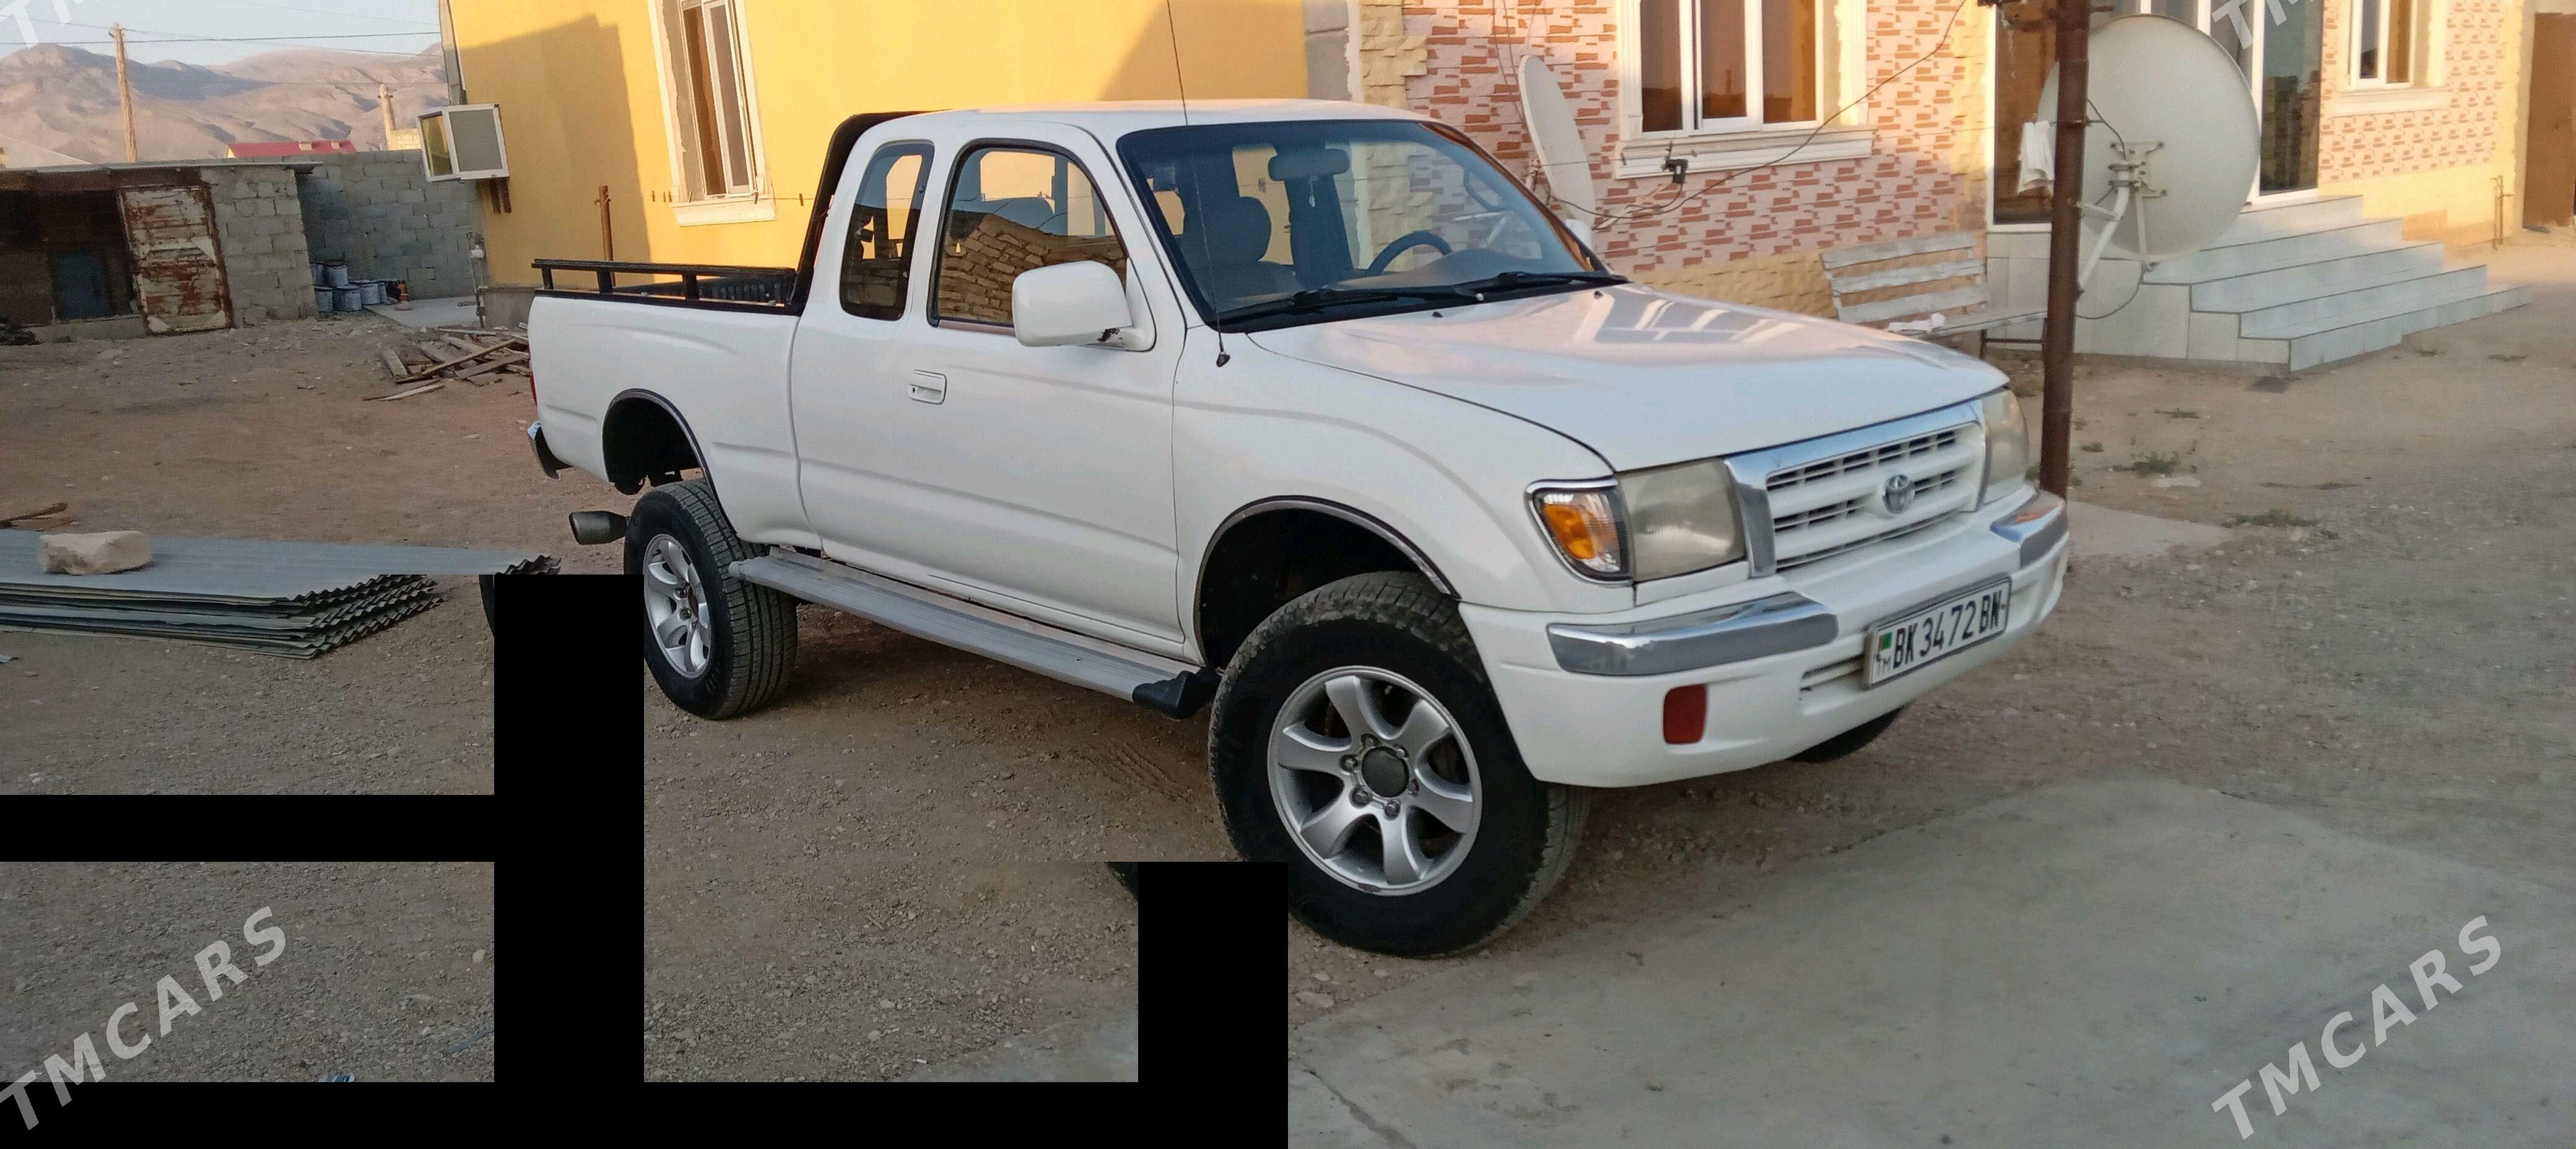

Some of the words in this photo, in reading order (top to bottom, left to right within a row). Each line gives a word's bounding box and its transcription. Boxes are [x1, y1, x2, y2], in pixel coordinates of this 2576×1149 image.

[1893, 622, 1918, 669] BK
[1919, 600, 1977, 657] 3472
[1978, 589, 2003, 634] BN
